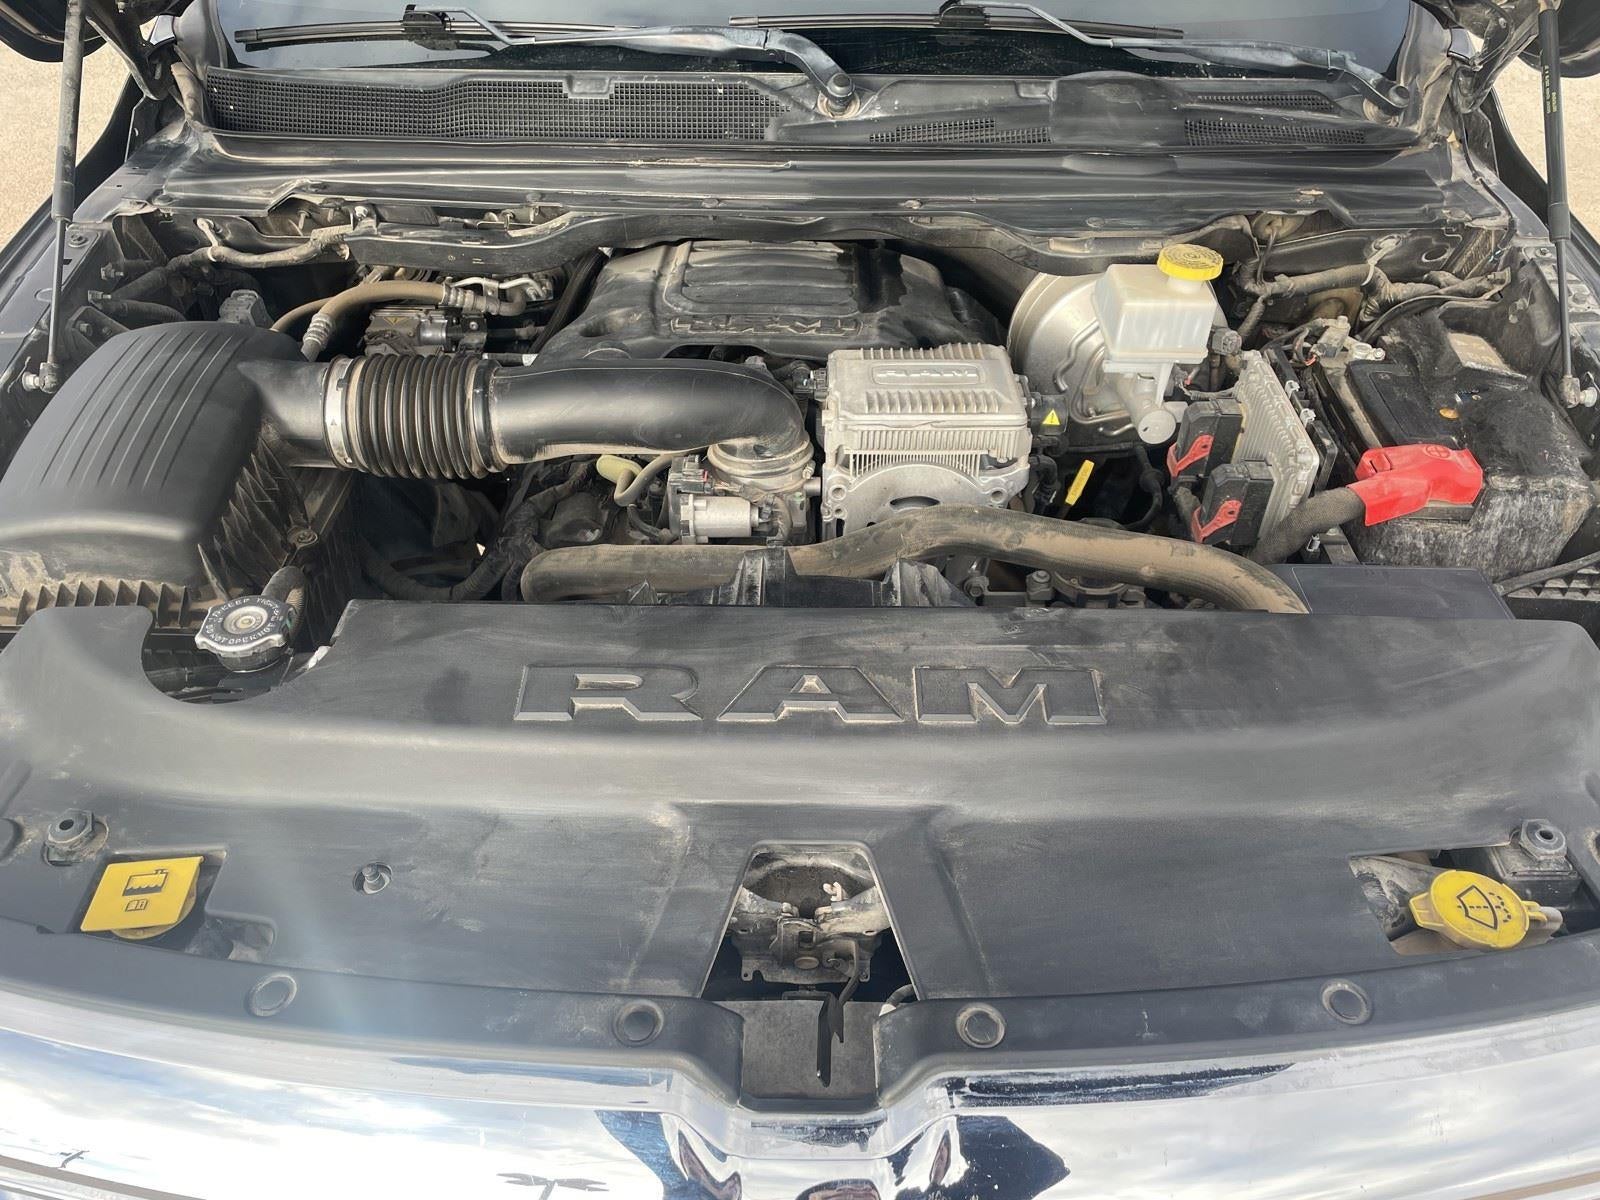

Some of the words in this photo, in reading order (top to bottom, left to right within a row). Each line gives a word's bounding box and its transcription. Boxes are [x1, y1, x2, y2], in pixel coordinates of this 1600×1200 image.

[876, 366, 979, 378] RAM
[222, 597, 250, 611] KEEP
[229, 633, 257, 644] OPEN
[514, 665, 1108, 725] RAM
